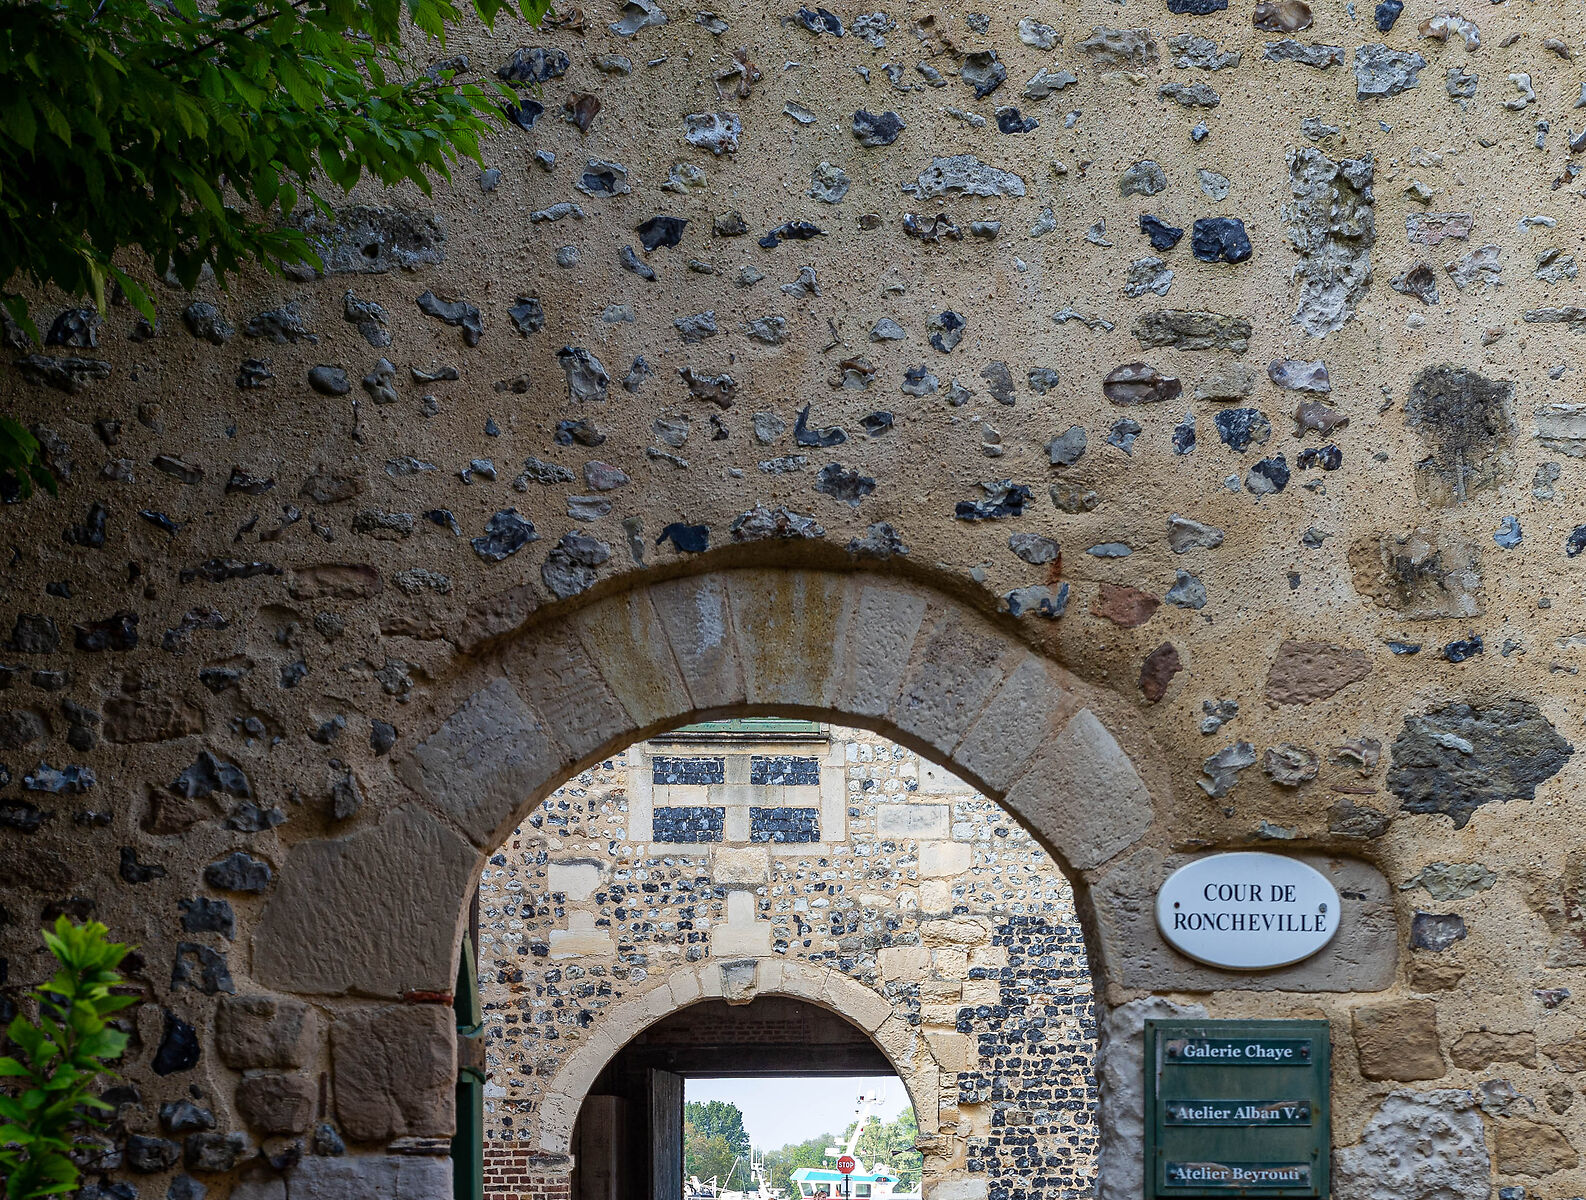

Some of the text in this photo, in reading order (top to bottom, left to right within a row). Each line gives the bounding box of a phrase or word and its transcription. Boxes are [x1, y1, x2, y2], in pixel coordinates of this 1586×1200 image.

[1204, 883, 1297, 903] COUR DE
[1173, 912, 1327, 932] RONCHEVILLE
[1183, 1044, 1293, 1061] Galerie Chaye
[1176, 1106, 1300, 1119] Atelier Alban V.
[1175, 1167, 1300, 1183] Atelier Beyrouti
